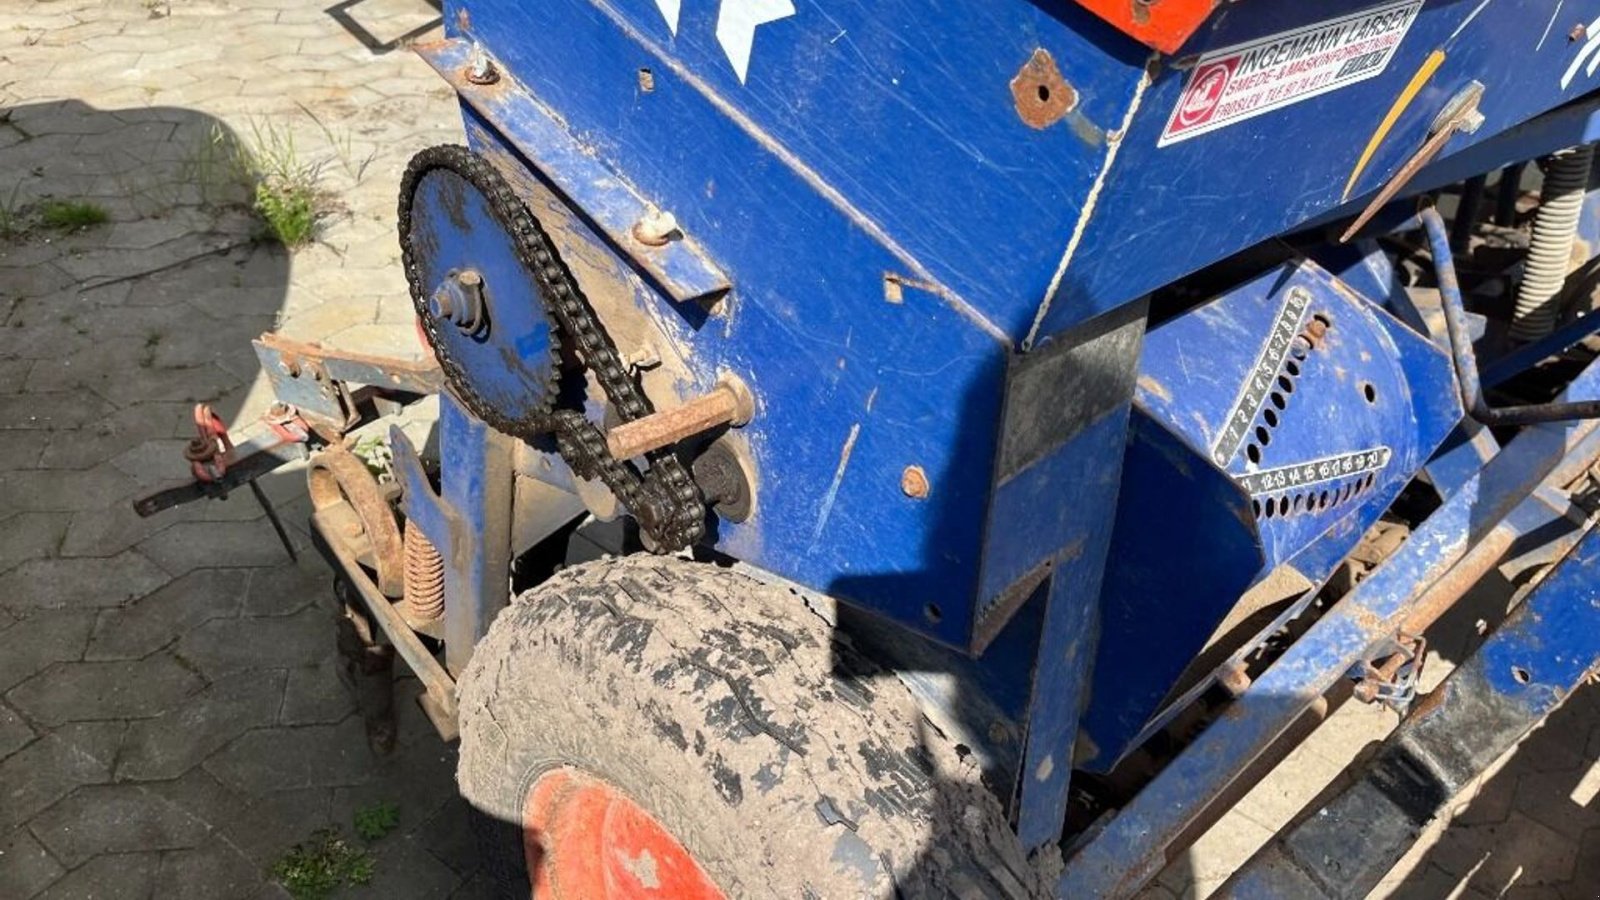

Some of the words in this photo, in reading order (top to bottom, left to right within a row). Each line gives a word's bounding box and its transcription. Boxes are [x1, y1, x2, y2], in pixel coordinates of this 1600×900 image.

[1234, 25, 1348, 77] INGEMANN
[1342, 5, 1416, 45] LARSEN
[1238, 409, 1249, 423] 2
[1246, 393, 1257, 407] 3
[1261, 362, 1273, 376] 5
[1268, 347, 1280, 361] 6
[1274, 333, 1288, 347] 7
[1261, 474, 1275, 490] 12
[1274, 470, 1286, 487] 13
[1289, 470, 1301, 485] 14
[1304, 465, 1316, 480] 15
[1319, 462, 1331, 478] 16
